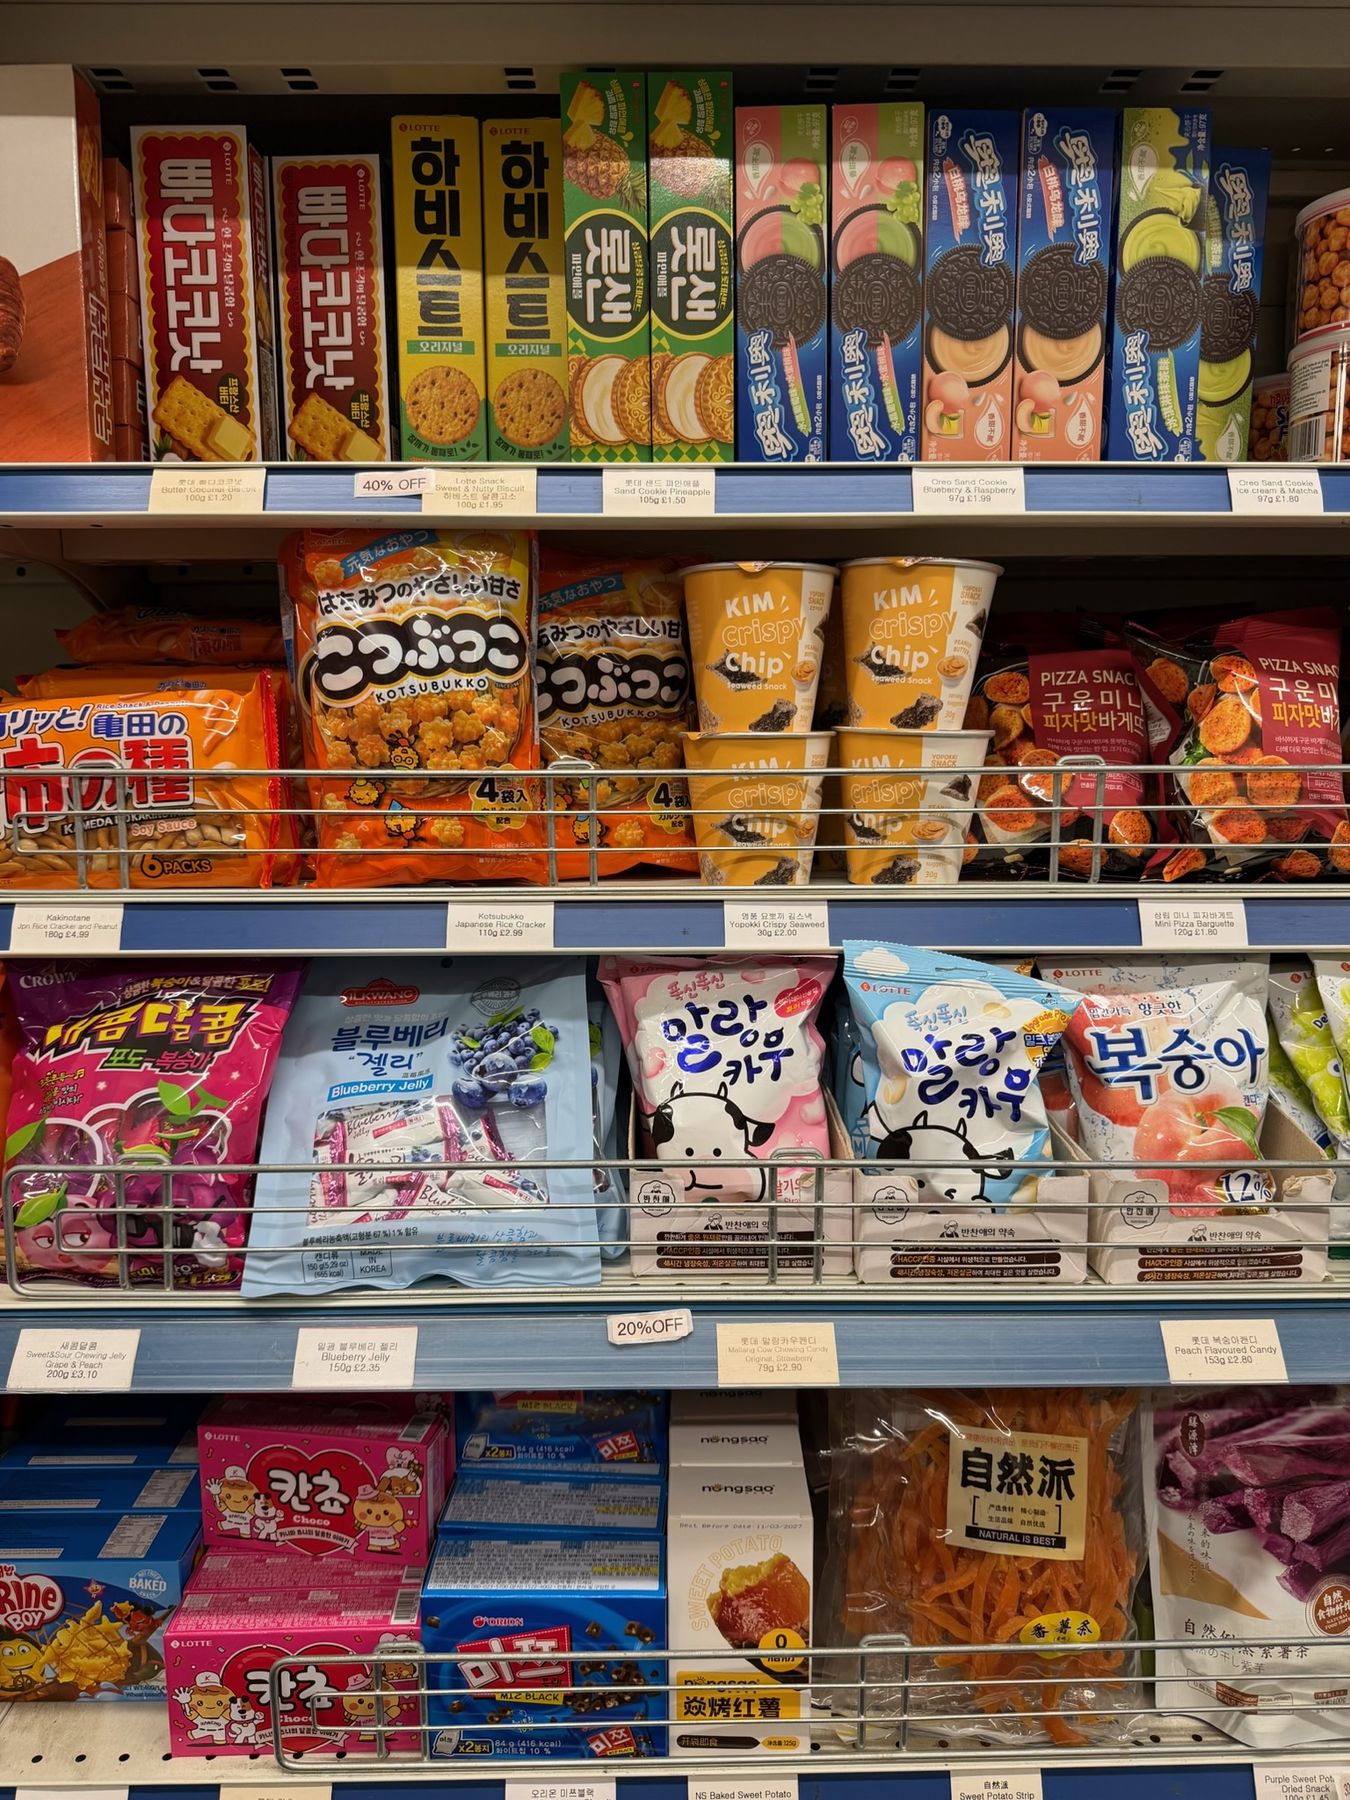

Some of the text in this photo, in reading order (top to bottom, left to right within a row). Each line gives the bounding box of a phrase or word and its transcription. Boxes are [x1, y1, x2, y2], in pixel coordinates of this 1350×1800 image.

[409, 124, 440, 132] LOTTE
[500, 127, 531, 135] LOTTE
[223, 153, 233, 186] LOTTE
[358, 179, 366, 211] LOTTE
[949, 166, 970, 234] 白桃乌龙味
[963, 134, 1007, 265] 奥利奥
[1042, 166, 1064, 228] 白桃乌龙味
[1058, 132, 1099, 263] 奥利奥
[410, 136, 463, 337] 하비스트
[500, 140, 550, 339] 하비스트
[159, 158, 223, 373] 빠다코코낫
[571, 253, 582, 300] 파인애플
[585, 228, 633, 323] 롯샌
[656, 252, 668, 297] 파인애플
[671, 226, 717, 321] 롯샌
[297, 185, 354, 390] 빠다코코낫
[419, 342, 463, 353] 오리지널
[507, 344, 551, 355] 오리지널
[219, 387, 228, 404] 버터
[747, 331, 794, 459] 奥利奥
[842, 330, 888, 458] 奥利奥
[1126, 332, 1162, 455] 奥利奥
[351, 402, 360, 420] 버터
[363, 478, 426, 491] 40% OFF
[931, 479, 1007, 487] Oreo Sand Cookie
[614, 488, 711, 497] Sand Cookie Pineapple
[923, 486, 1016, 495] Blueberry & Raspberry
[639, 496, 686, 504] 105g £1.50
[948, 495, 991, 503] 97g £1.99
[457, 501, 503, 510] 100g £1.95
[345, 531, 429, 573] 元気なおやつ
[873, 584, 923, 611] KIM
[725, 592, 774, 618] KIM
[871, 674, 932, 685] Seaweed Snack
[375, 677, 487, 703] KOTSUBUKKO
[727, 682, 787, 690] Seaweed Snack
[561, 709, 655, 727] KOTSUBUKKO
[931, 760, 957, 769] SNACK
[131, 823, 154, 837] Soy
[156, 818, 197, 833] Sauce
[141, 852, 212, 877] 6 PACKS
[730, 921, 760, 929] Yopokki
[762, 921, 788, 929] Crispy
[1196, 920, 1235, 929] Barguette
[44, 931, 63, 939] 180g
[757, 929, 772, 937] 30g
[1173, 928, 1193, 936] 120g
[1065, 969, 1102, 977] LOTTE
[668, 972, 725, 1000] 폭신폭신
[872, 985, 911, 996] LOTTE
[45, 998, 247, 1047] 새콤달콤
[904, 1003, 969, 1032] 폭신폭신
[331, 1017, 449, 1052] 블루베리
[1086, 1028, 1265, 1100] 복숭아
[332, 1077, 429, 1098] Blueberry Jelly
[961, 1228, 1016, 1238] 반찬애의 약속
[1209, 1231, 1262, 1239] 반찬애의 약속
[360, 1265, 387, 1274] KOREA
[617, 1317, 684, 1336] 20%OFF
[26, 1351, 127, 1361] Sweet&Sour Chewing Jelly
[321, 1352, 390, 1362] Blueberry Jelly
[1175, 1346, 1277, 1356] Peach Flavoured Candy
[45, 1361, 103, 1370] Grape & Peach
[1204, 1355, 1252, 1365] 153g £2.80
[329, 1363, 380, 1373] 150g £2.35
[758, 1363, 802, 1373] 79g £2.90
[46, 1370, 97, 1380] 200g £3.10
[213, 1433, 240, 1442] LOTTE
[700, 1435, 768, 1445] nongsao
[960, 1446, 1076, 1501] 自然派
[269, 1469, 350, 1514] 칸쵸
[702, 1483, 774, 1494] nongsao
[293, 1514, 330, 1526] Choco
[978, 1530, 1057, 1546] NATURAL IS BEST
[129, 1577, 168, 1592] BAKED
[1323, 1589, 1343, 1606] 自然
[486, 1618, 524, 1626] ORION
[1031, 1617, 1092, 1638] 番薯条
[181, 1639, 213, 1648] LOTTE
[247, 1665, 340, 1711] 칸쵸
[684, 1696, 781, 1718] 焱烤红薯
[518, 1739, 538, 1747] (416
[540, 1739, 562, 1747] kcal)
[496, 1747, 551, 1755] 화이트칩 10 %
[695, 1790, 792, 1800] NS Baked Sweet Potato
[1281, 1785, 1330, 1793] Dried Snack
[960, 1791, 1035, 1800] Sweet Potato Strip
